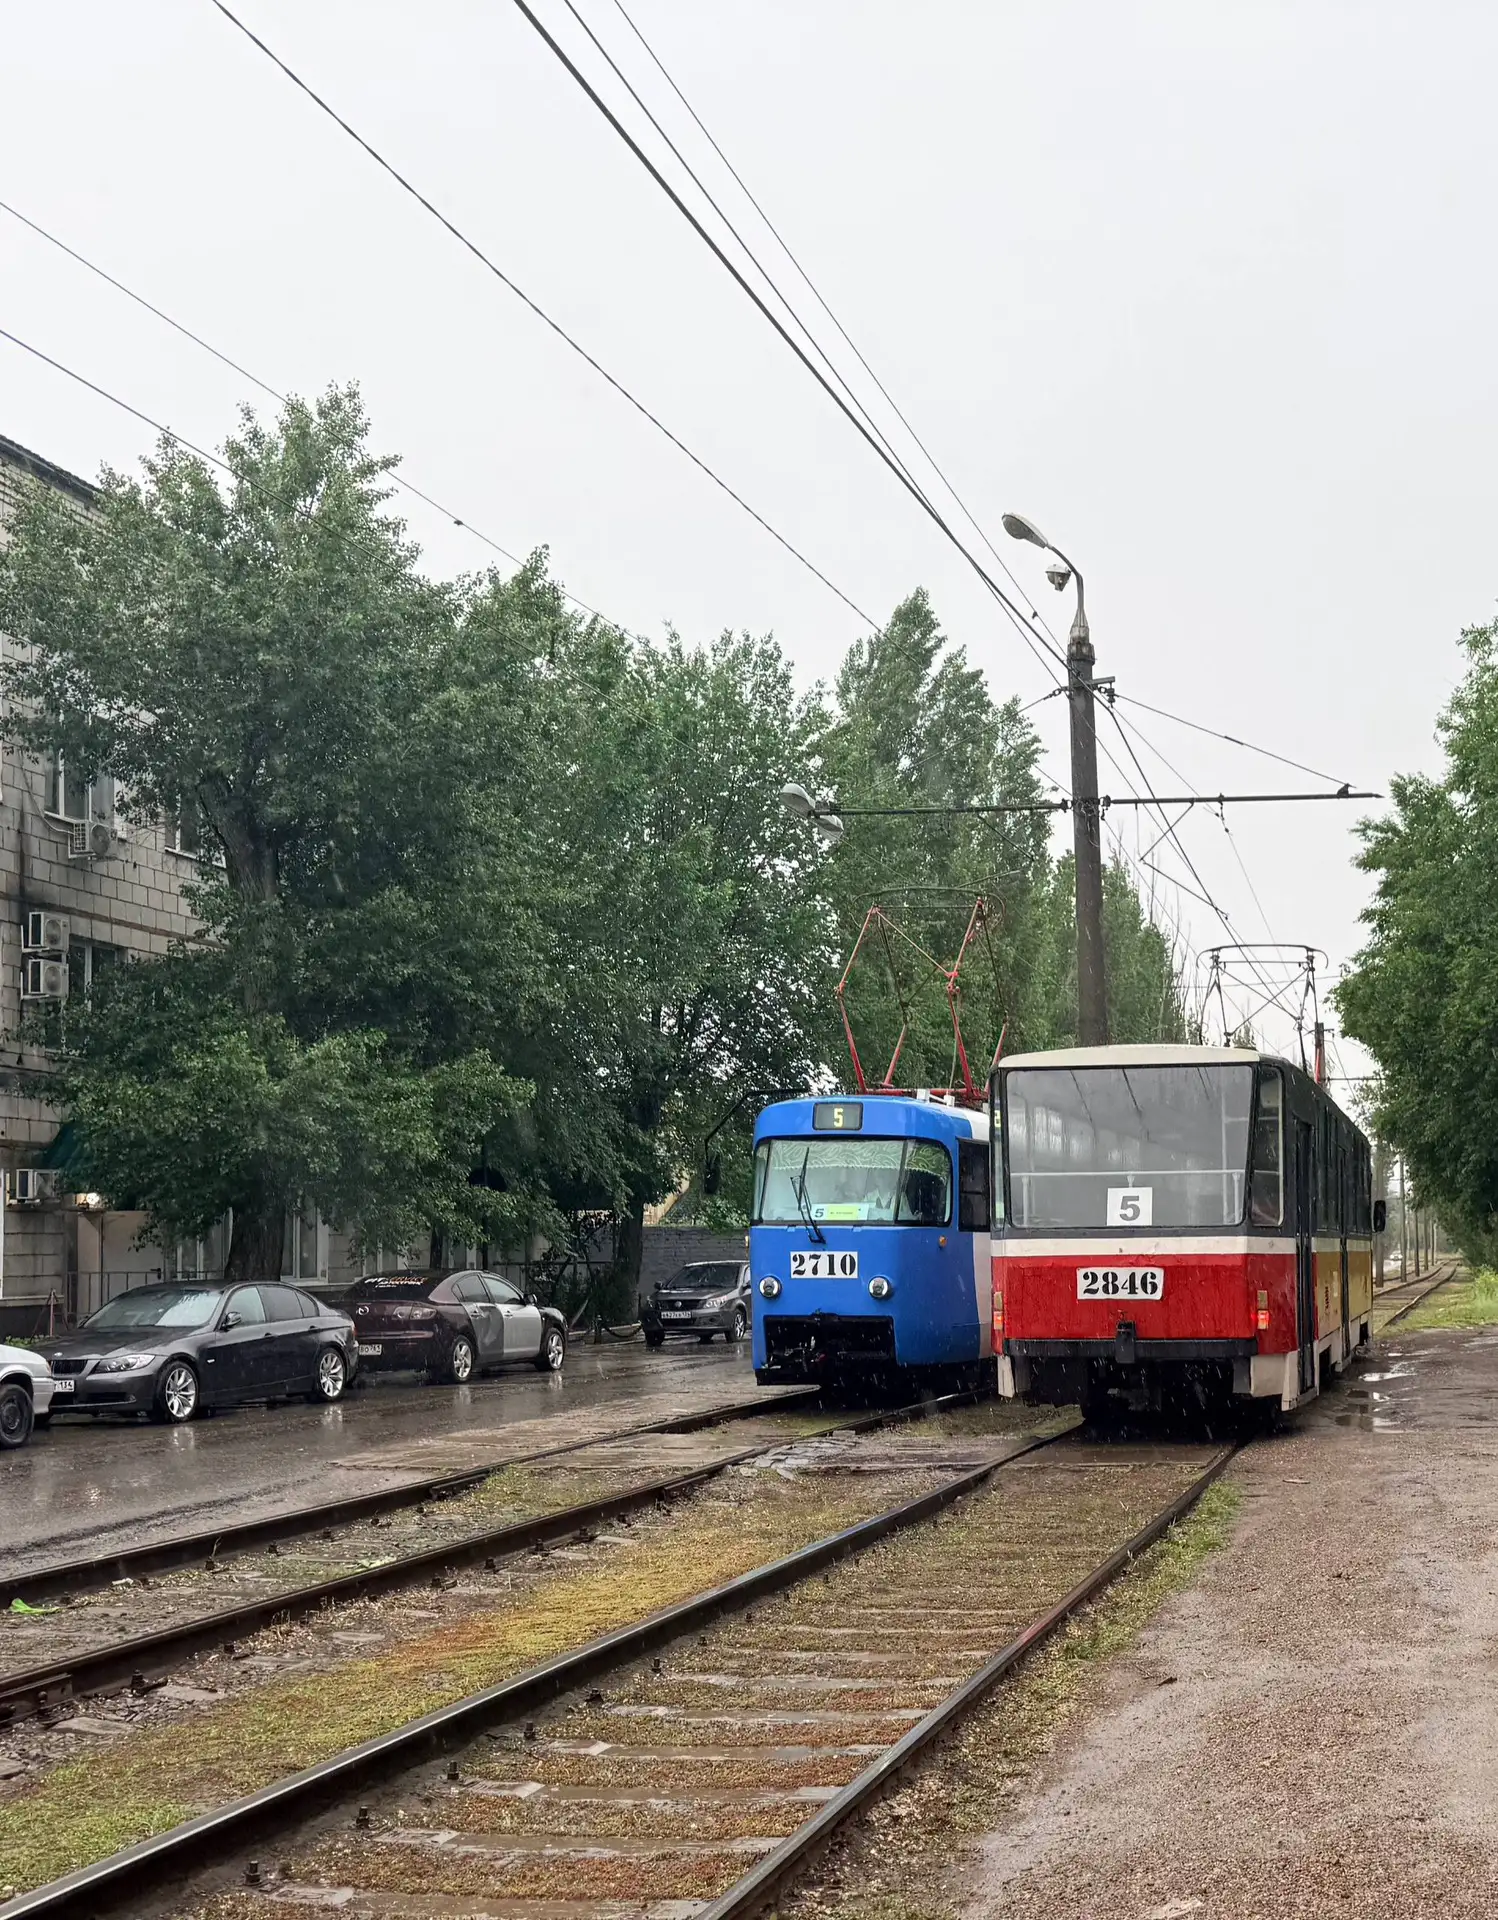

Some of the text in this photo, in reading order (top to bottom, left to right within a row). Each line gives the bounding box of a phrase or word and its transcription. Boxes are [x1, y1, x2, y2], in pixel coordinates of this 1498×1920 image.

[833, 1107, 844, 1128] 5
[814, 1208, 825, 1218] 5
[1119, 1195, 1141, 1222] 5
[792, 1253, 857, 1276] 2710
[1082, 1271, 1158, 1295] 2846
